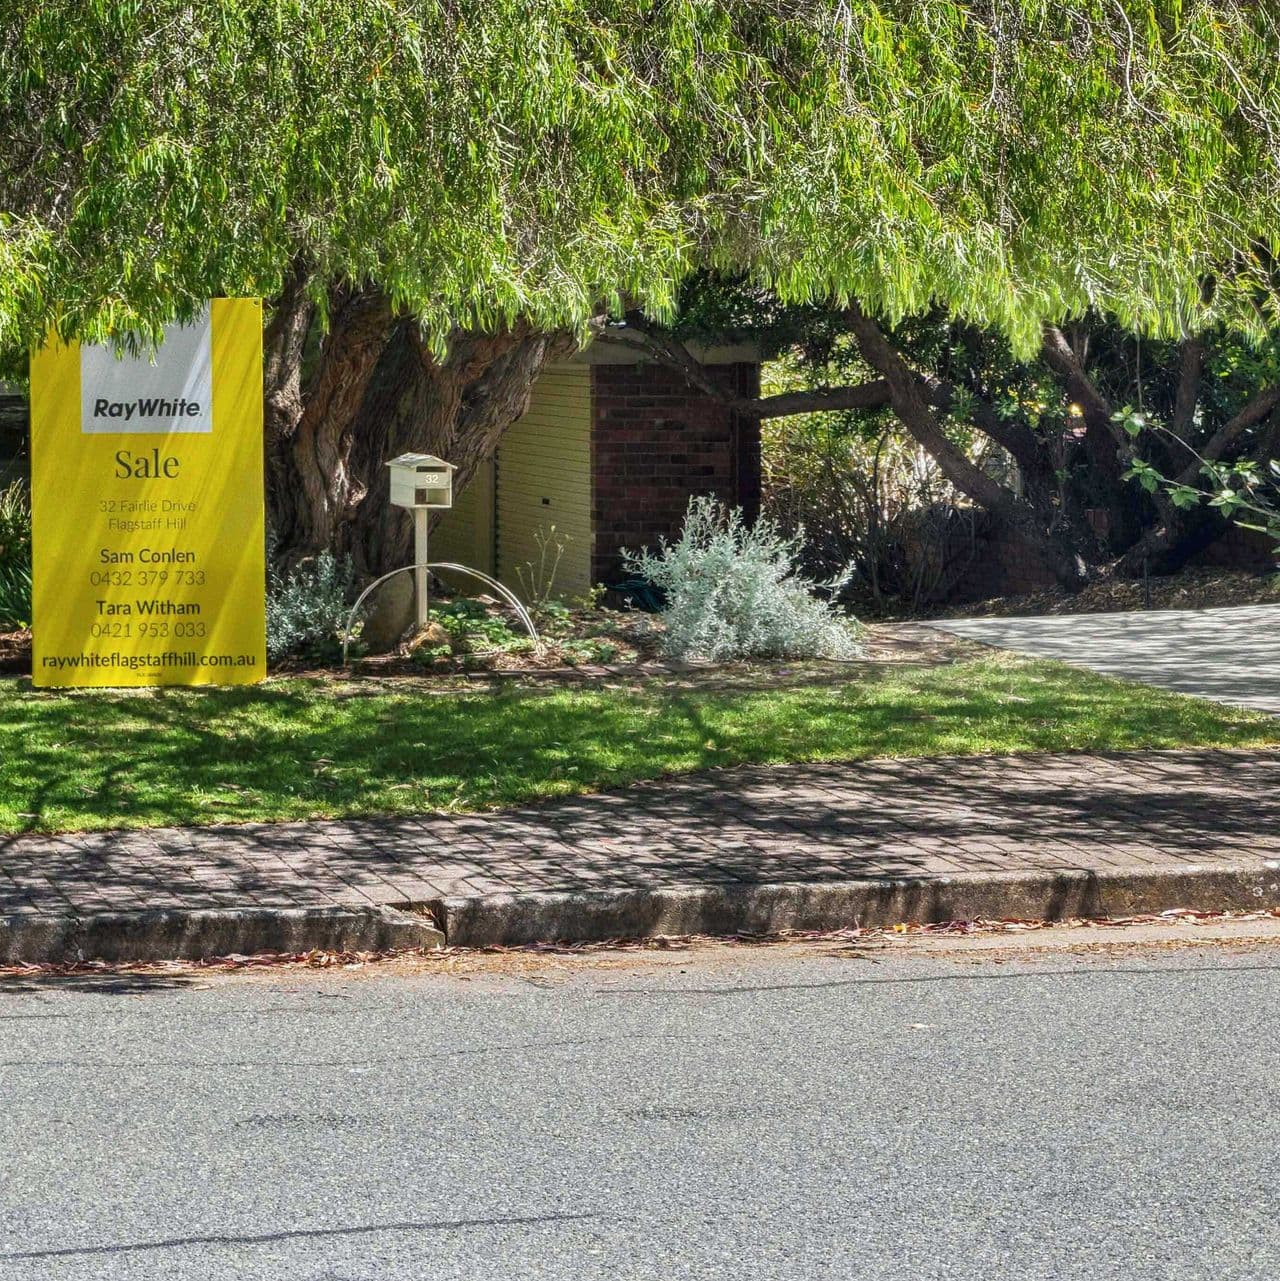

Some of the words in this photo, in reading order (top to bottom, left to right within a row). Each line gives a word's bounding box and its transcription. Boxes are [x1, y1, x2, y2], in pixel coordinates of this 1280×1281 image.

[115, 448, 180, 479] Sale
[425, 474, 439, 484] 32
[99, 500, 116, 513] 32
[120, 500, 157, 513] Fairlie
[161, 500, 197, 513] Drive
[108, 518, 162, 532] Flagstaff
[167, 518, 187, 530] Hill
[100, 549, 134, 564] Sam
[139, 548, 196, 564] Conlen
[90, 571, 132, 587] 0432
[138, 571, 169, 587] 379
[176, 571, 206, 587] 733
[96, 600, 131, 615] Tara
[137, 600, 201, 615] Witham
[90, 622, 131, 638] 0421
[138, 622, 169, 638] 953
[174, 622, 206, 638] 033
[42, 652, 256, 670] raywhiteflagstaffhill.com.au
